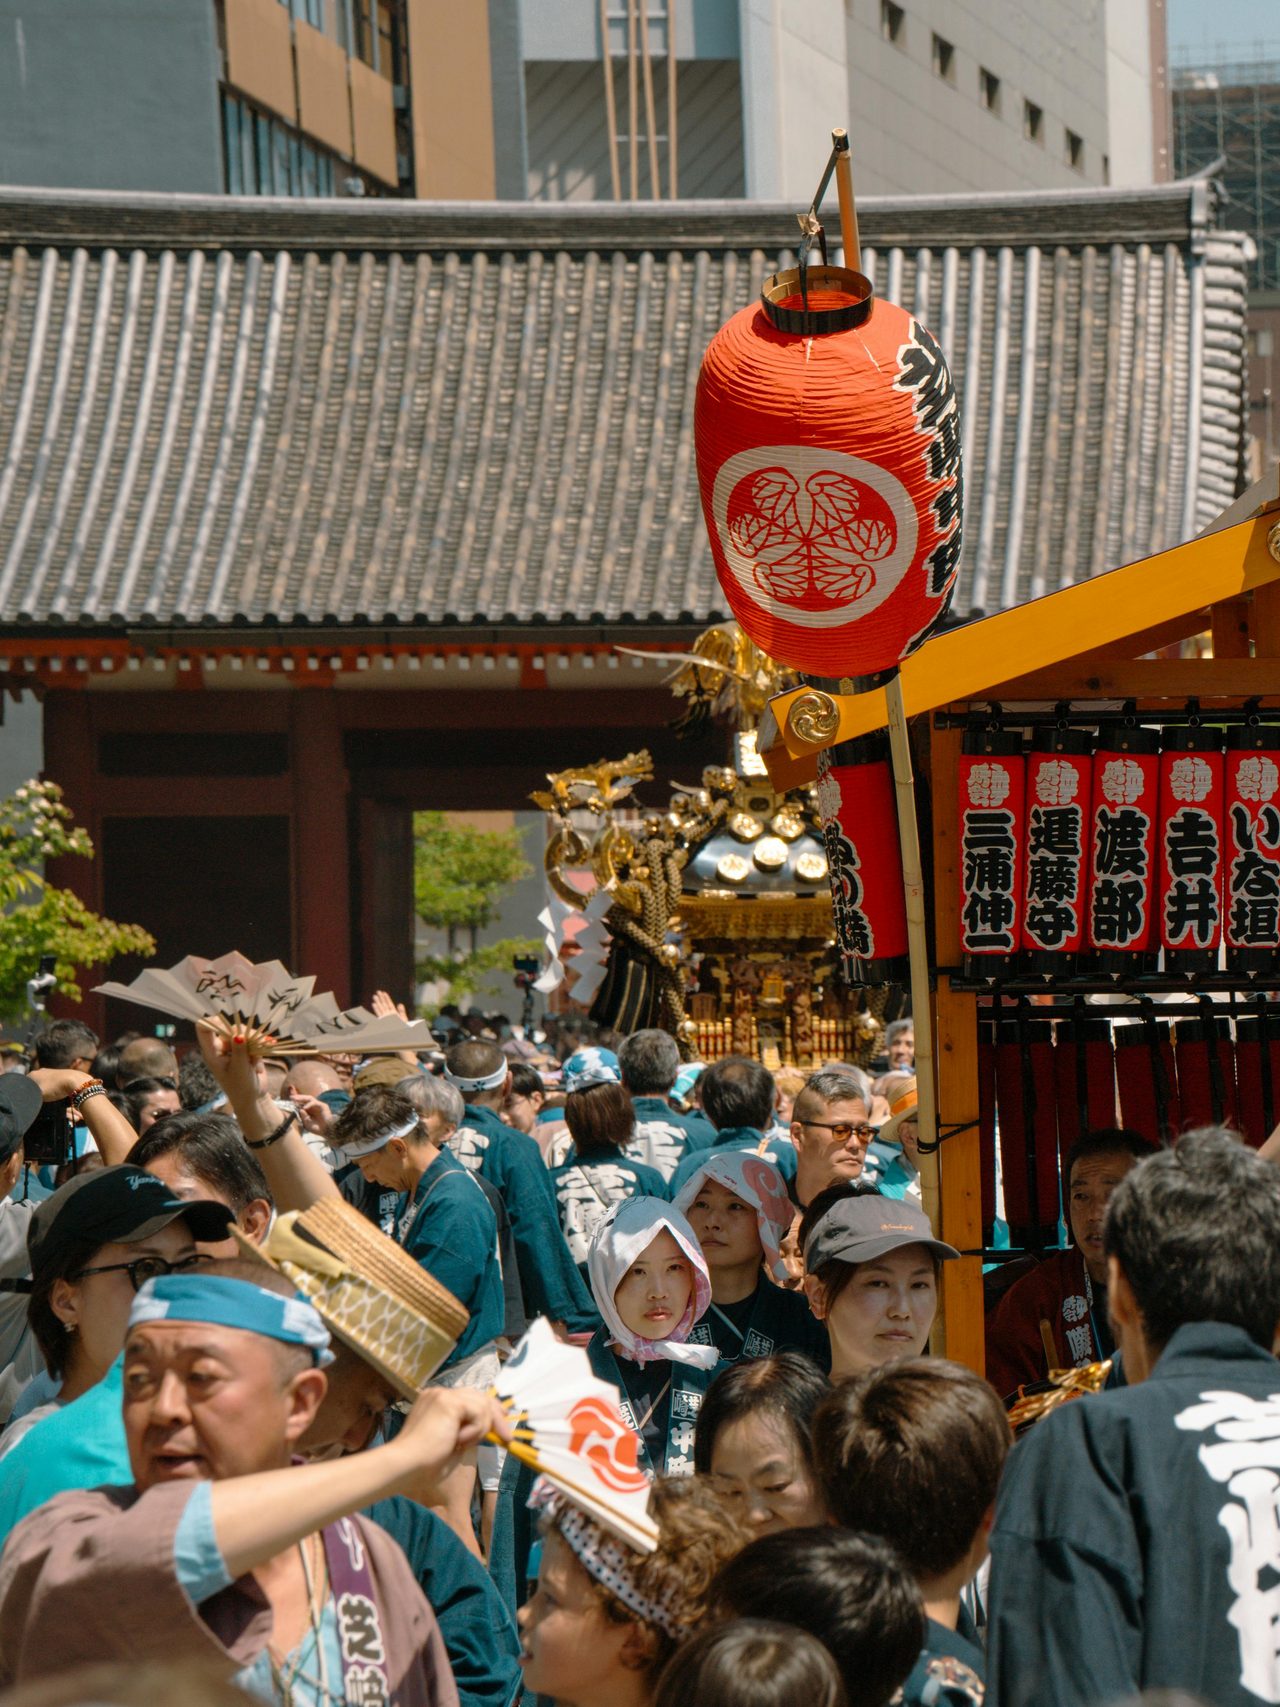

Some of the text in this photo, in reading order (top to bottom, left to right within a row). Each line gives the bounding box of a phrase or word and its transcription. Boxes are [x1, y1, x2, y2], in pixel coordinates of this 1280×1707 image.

[963, 809, 1016, 951] 三浦伸一
[1091, 804, 1150, 947] 渡部
